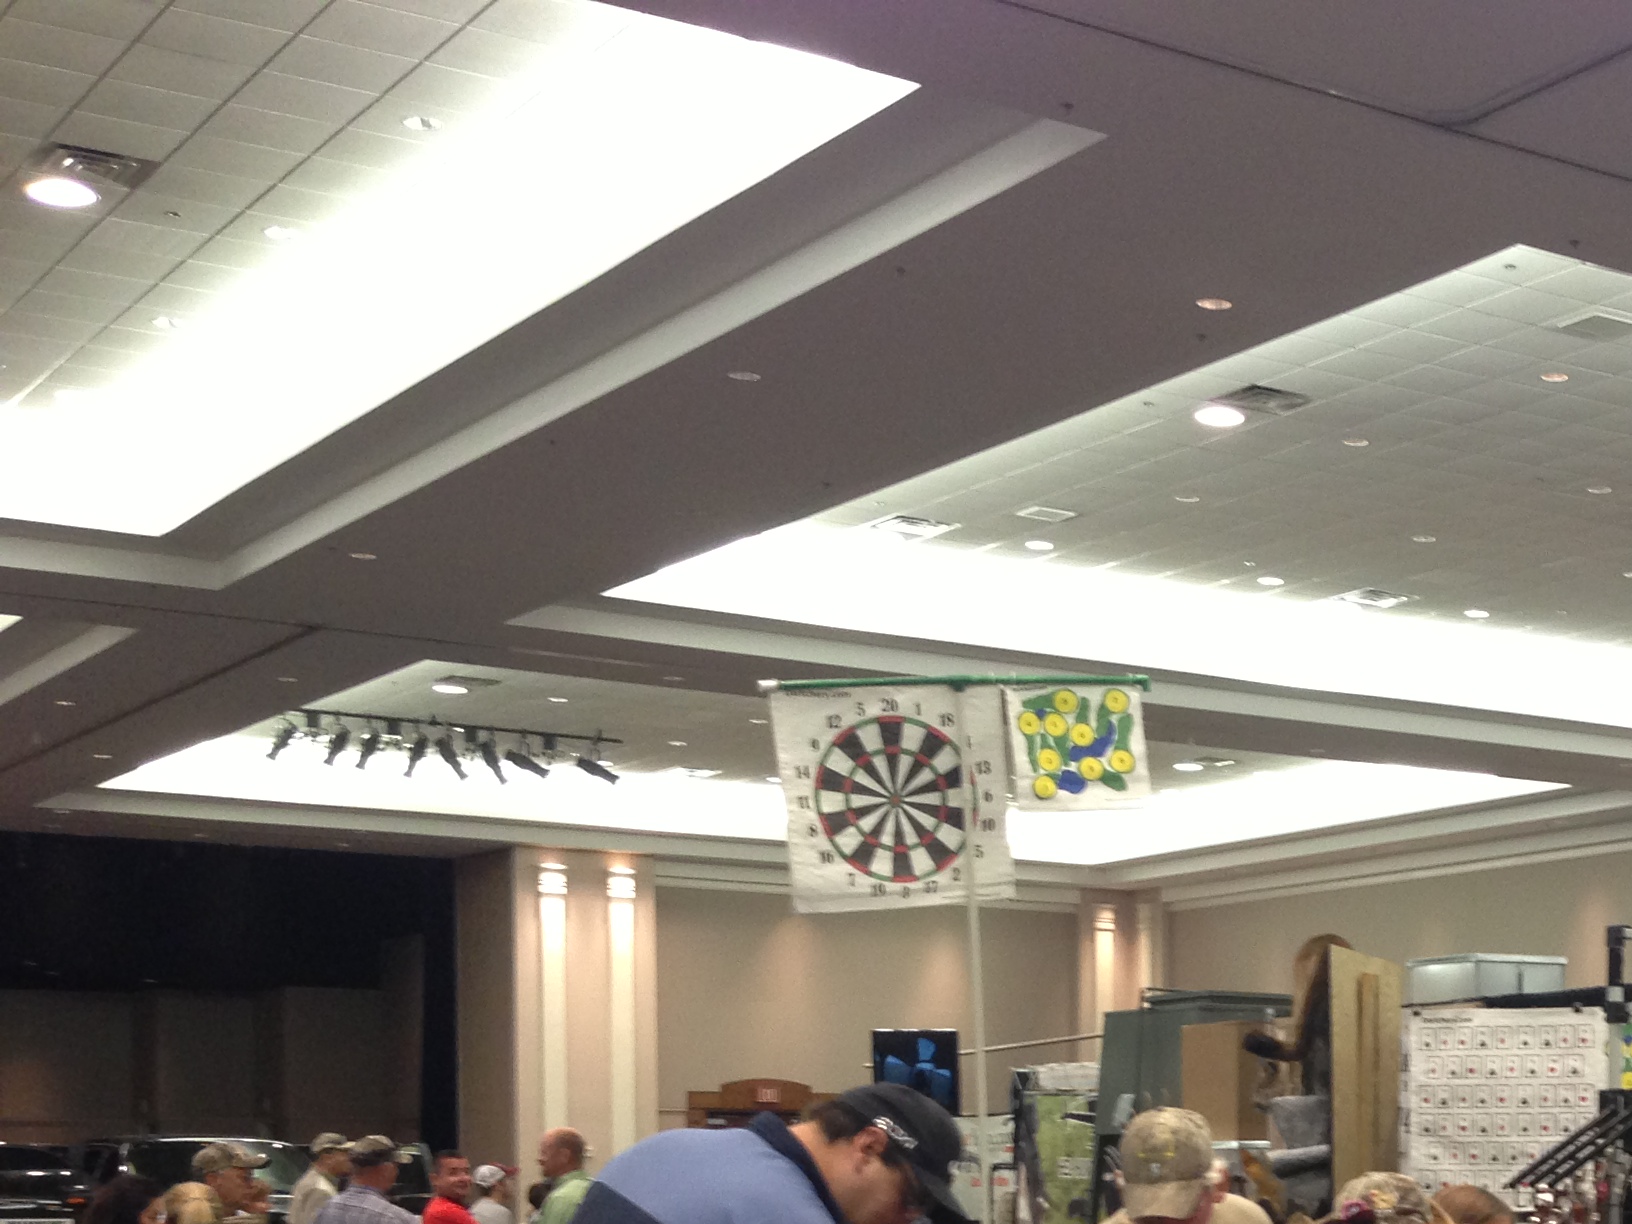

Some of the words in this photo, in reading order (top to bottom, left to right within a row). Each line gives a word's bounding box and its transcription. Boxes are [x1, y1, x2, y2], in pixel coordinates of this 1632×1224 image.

[856, 701, 866, 717] 5
[881, 697, 899, 712] 20
[913, 703, 922, 716] 1
[827, 714, 843, 729] 12
[939, 712, 955, 727] 18
[981, 818, 996, 832] 10
[952, 867, 961, 881] 2
